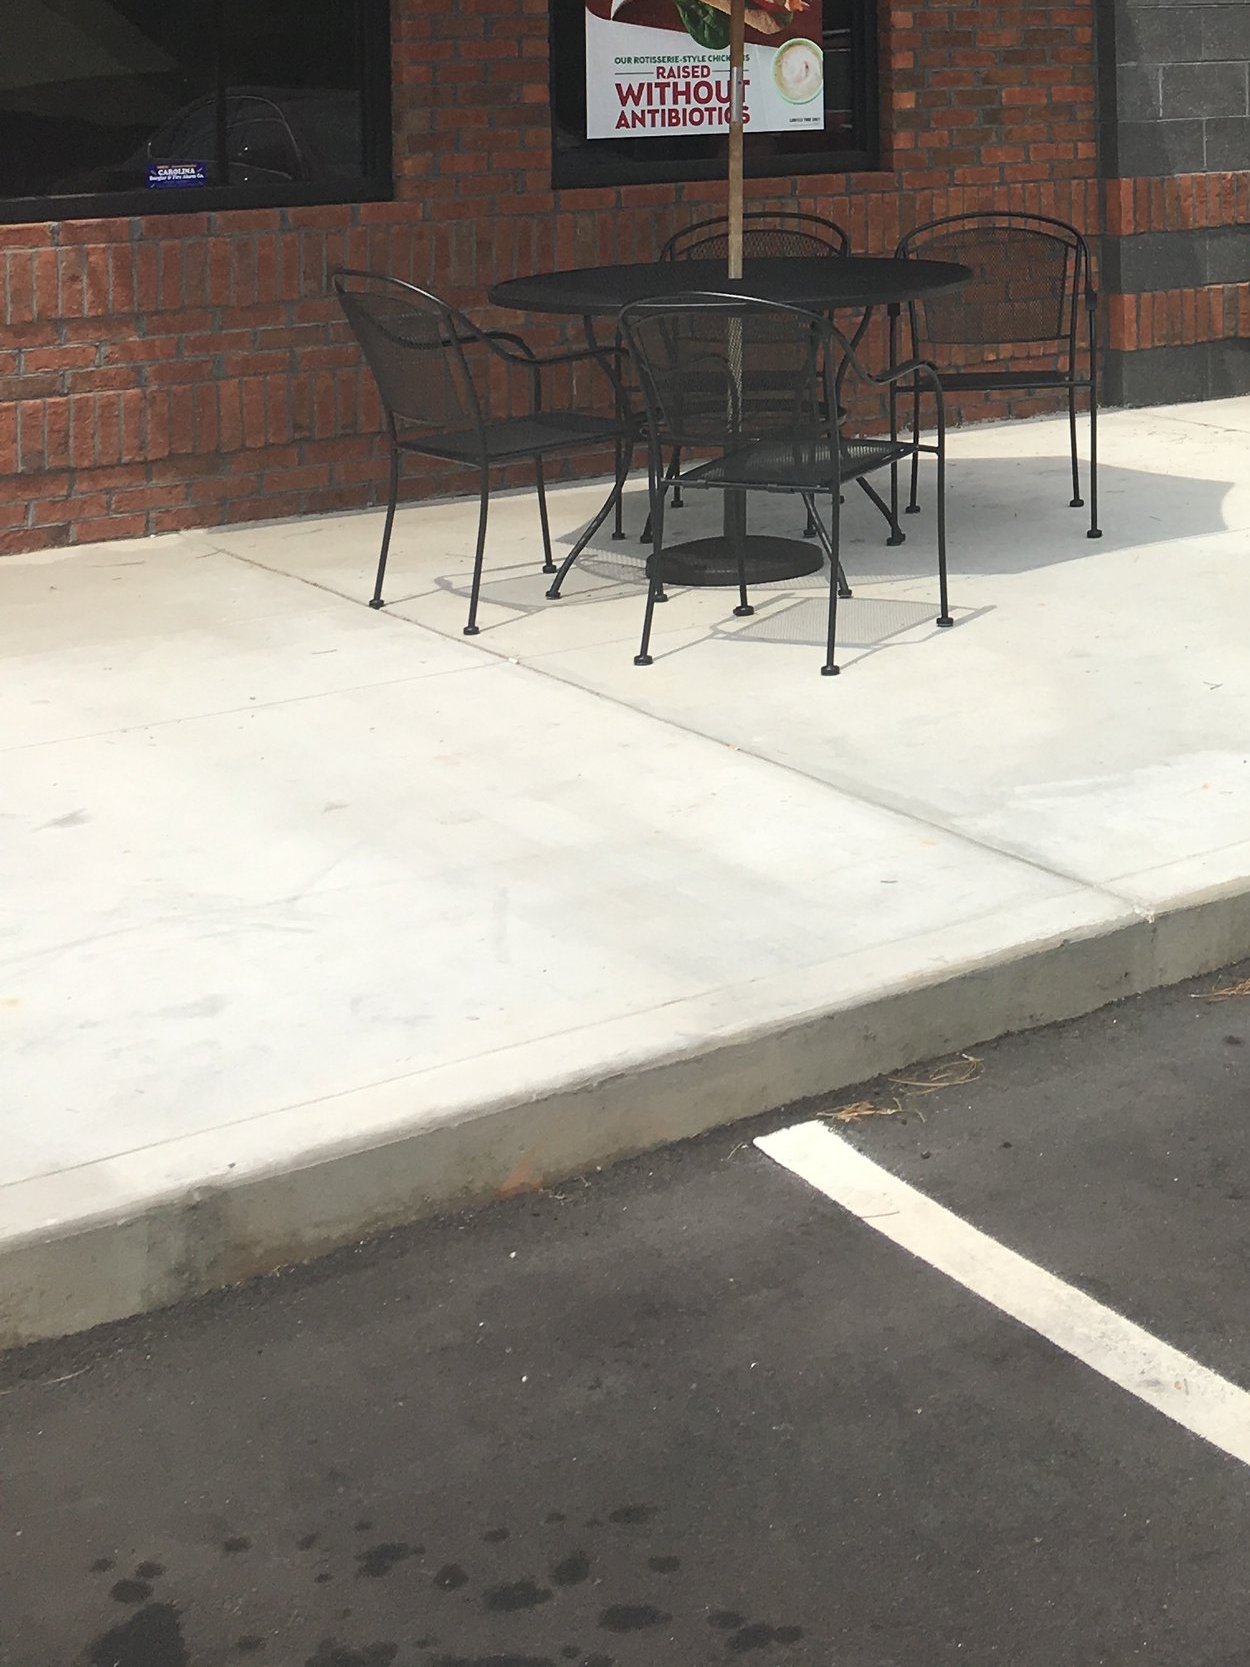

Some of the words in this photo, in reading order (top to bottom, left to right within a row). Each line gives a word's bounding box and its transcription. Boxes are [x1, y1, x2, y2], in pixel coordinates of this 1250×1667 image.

[614, 56, 632, 64] OUR
[633, 54, 706, 64] ROTISSERIE-STYLE
[656, 65, 711, 79] RAISED
